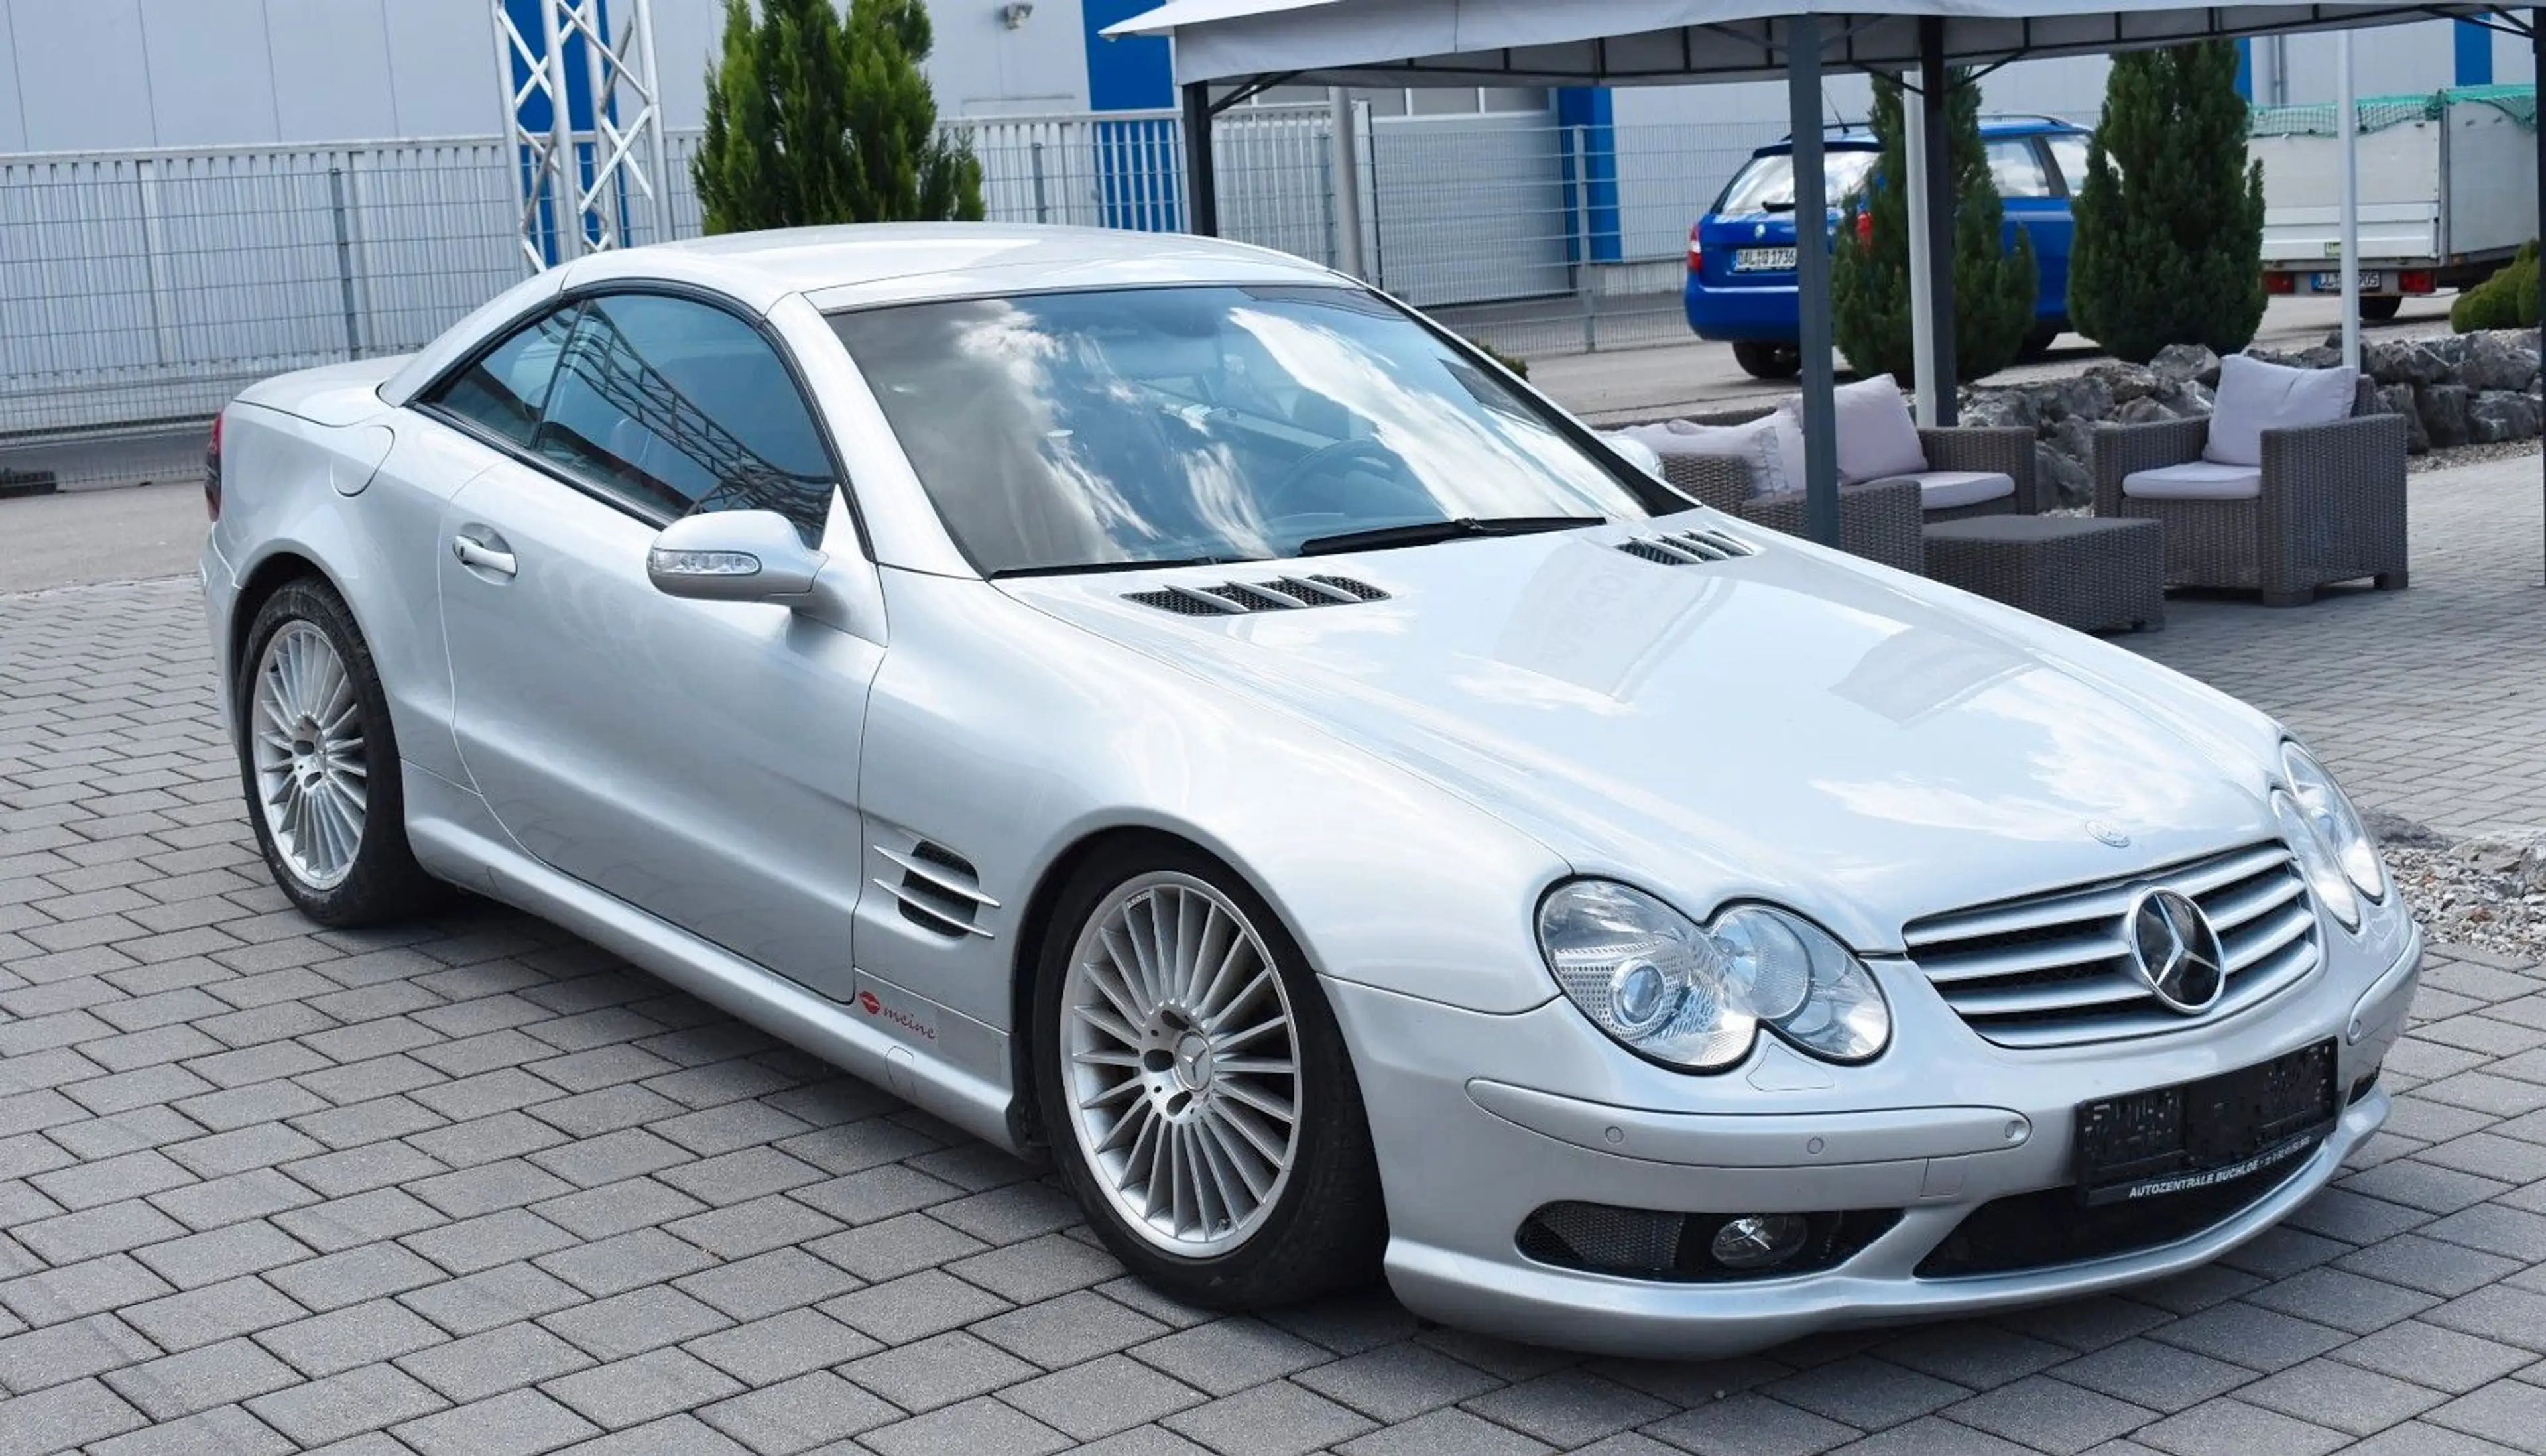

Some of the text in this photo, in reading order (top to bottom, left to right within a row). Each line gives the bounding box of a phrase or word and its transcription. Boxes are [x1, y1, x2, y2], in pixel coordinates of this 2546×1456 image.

[884, 1007, 936, 1040] meine
[2128, 1158, 2259, 1198] AUTOZENTRALE BUCHLOE
